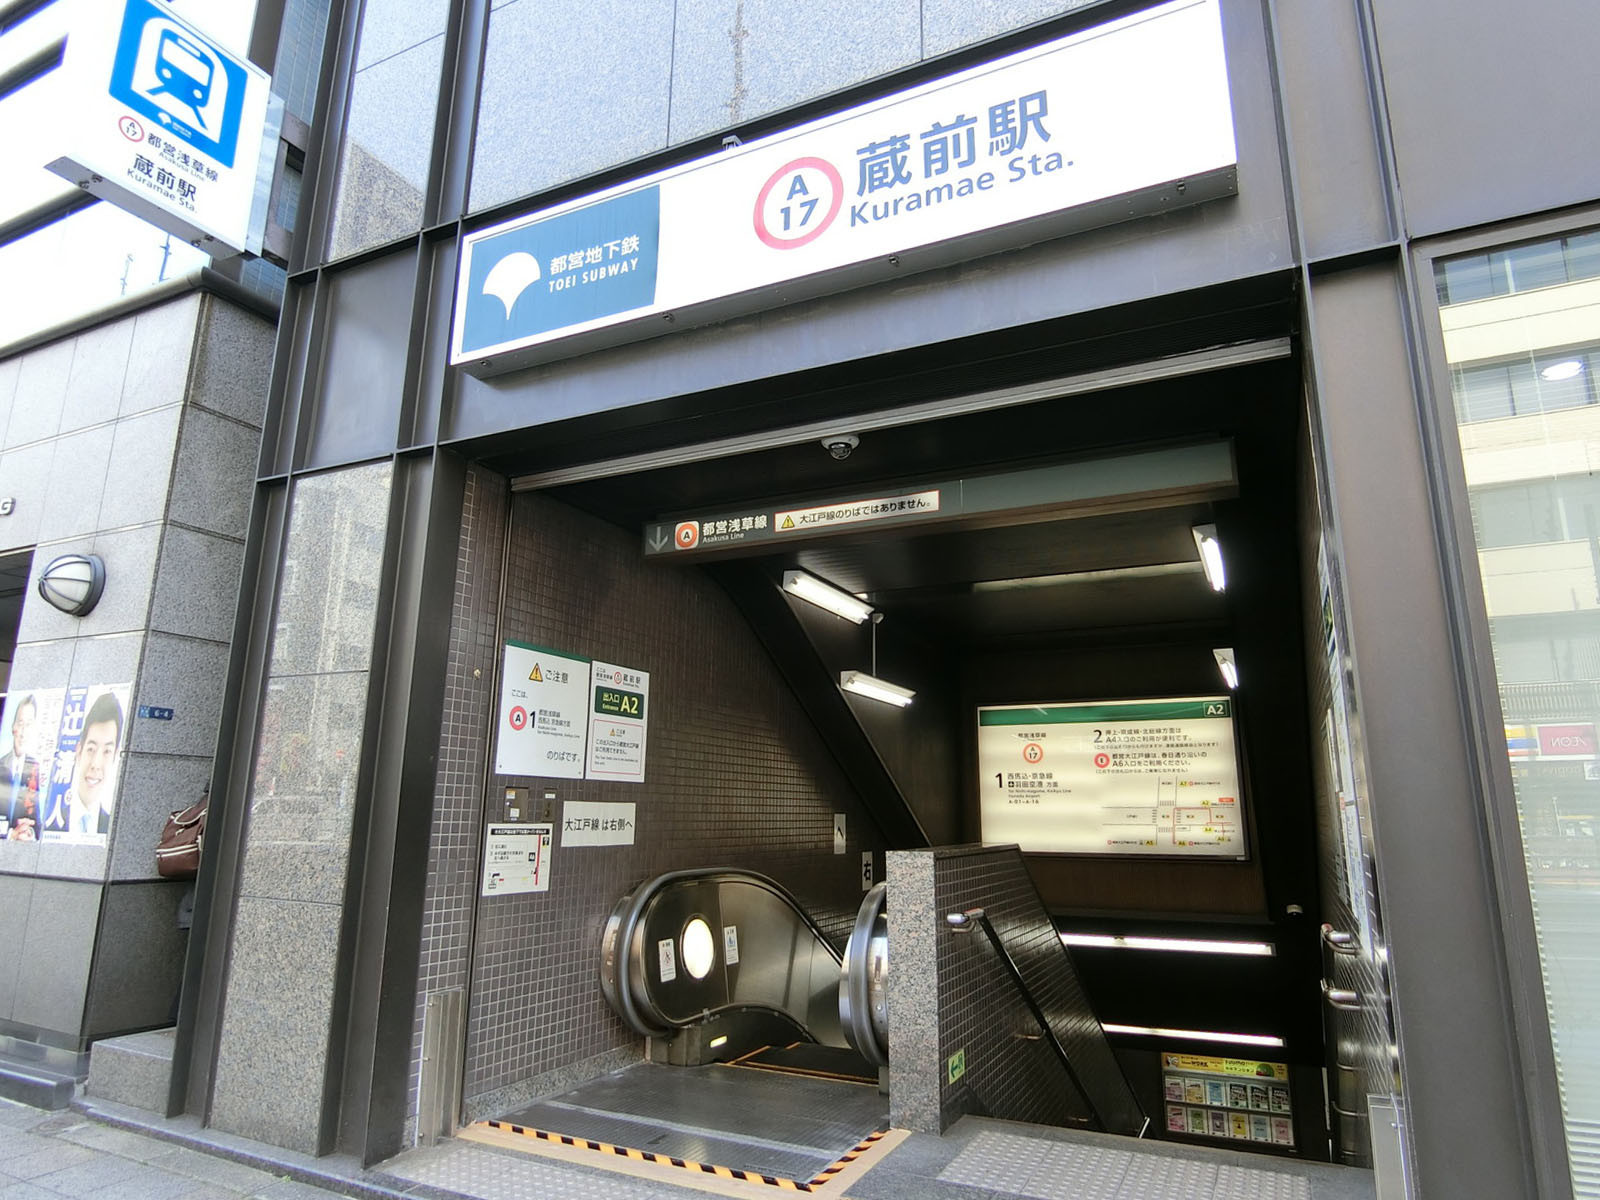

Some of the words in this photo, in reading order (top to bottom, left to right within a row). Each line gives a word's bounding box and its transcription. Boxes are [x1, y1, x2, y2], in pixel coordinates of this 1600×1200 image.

[126, 126, 138, 137] 17
[856, 89, 1052, 198] 蔵前駅
[147, 132, 219, 182] 都営浅草線
[159, 151, 189, 173] Asakusa
[133, 153, 197, 202] 蔵前駅
[786, 174, 810, 200] A
[127, 168, 176, 201] Kuramae
[178, 197, 198, 213] Sta.
[850, 172, 995, 227] Kuramae
[1008, 151, 1075, 183] Sta.
[779, 198, 819, 231] 17
[549, 234, 640, 276] 都営地下鉄
[549, 275, 577, 293] TOEI
[582, 257, 639, 284] SUBWAY
[799, 498, 931, 524] 大江戸線のりばではありません。
[702, 514, 768, 536] 都営浅草線
[683, 531, 691, 540] A
[702, 535, 729, 544] Asakusa
[730, 532, 745, 540] Line
[545, 669, 569, 684] ご注意
[602, 692, 620, 703] 出入口
[620, 695, 639, 714] A2
[515, 714, 521, 722] A
[530, 710, 536, 728] 1
[1207, 704, 1225, 715] A2
[1093, 729, 1102, 743] 2
[546, 750, 581, 763] のりばです。
[1028, 752, 1038, 760] 17
[995, 772, 1003, 789] 1
[564, 817, 600, 832] 大江戸線
[601, 817, 633, 832] は右側へ
[863, 860, 872, 881] 右
